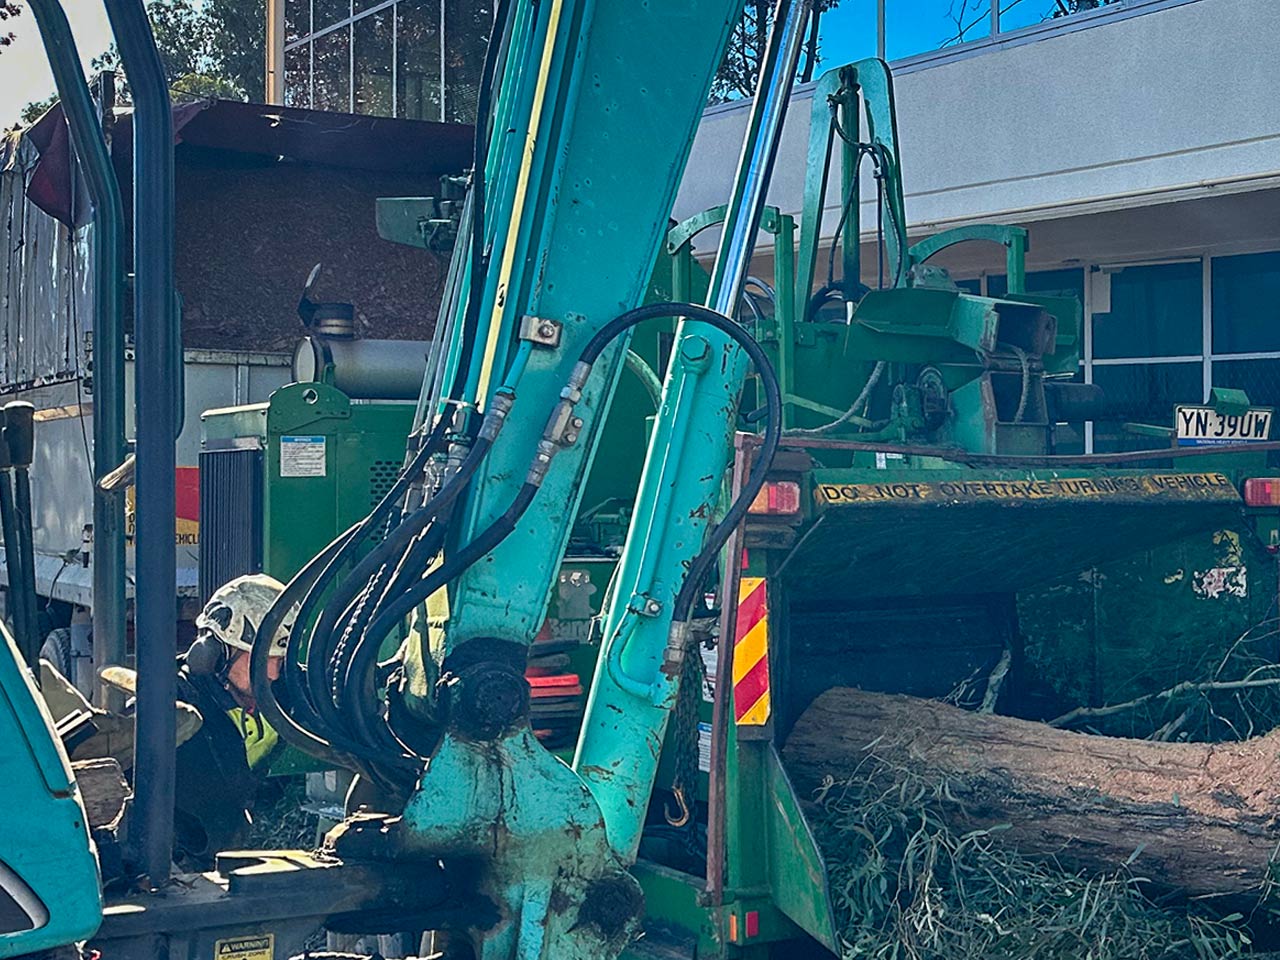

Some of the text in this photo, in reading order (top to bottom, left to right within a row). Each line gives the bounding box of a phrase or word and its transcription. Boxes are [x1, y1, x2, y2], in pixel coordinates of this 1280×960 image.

[823, 474, 1229, 500] DO NOT OVERTAKE TURNING VEHICLE
[175, 533, 199, 545] EHICL
[231, 939, 269, 950] WARNING
